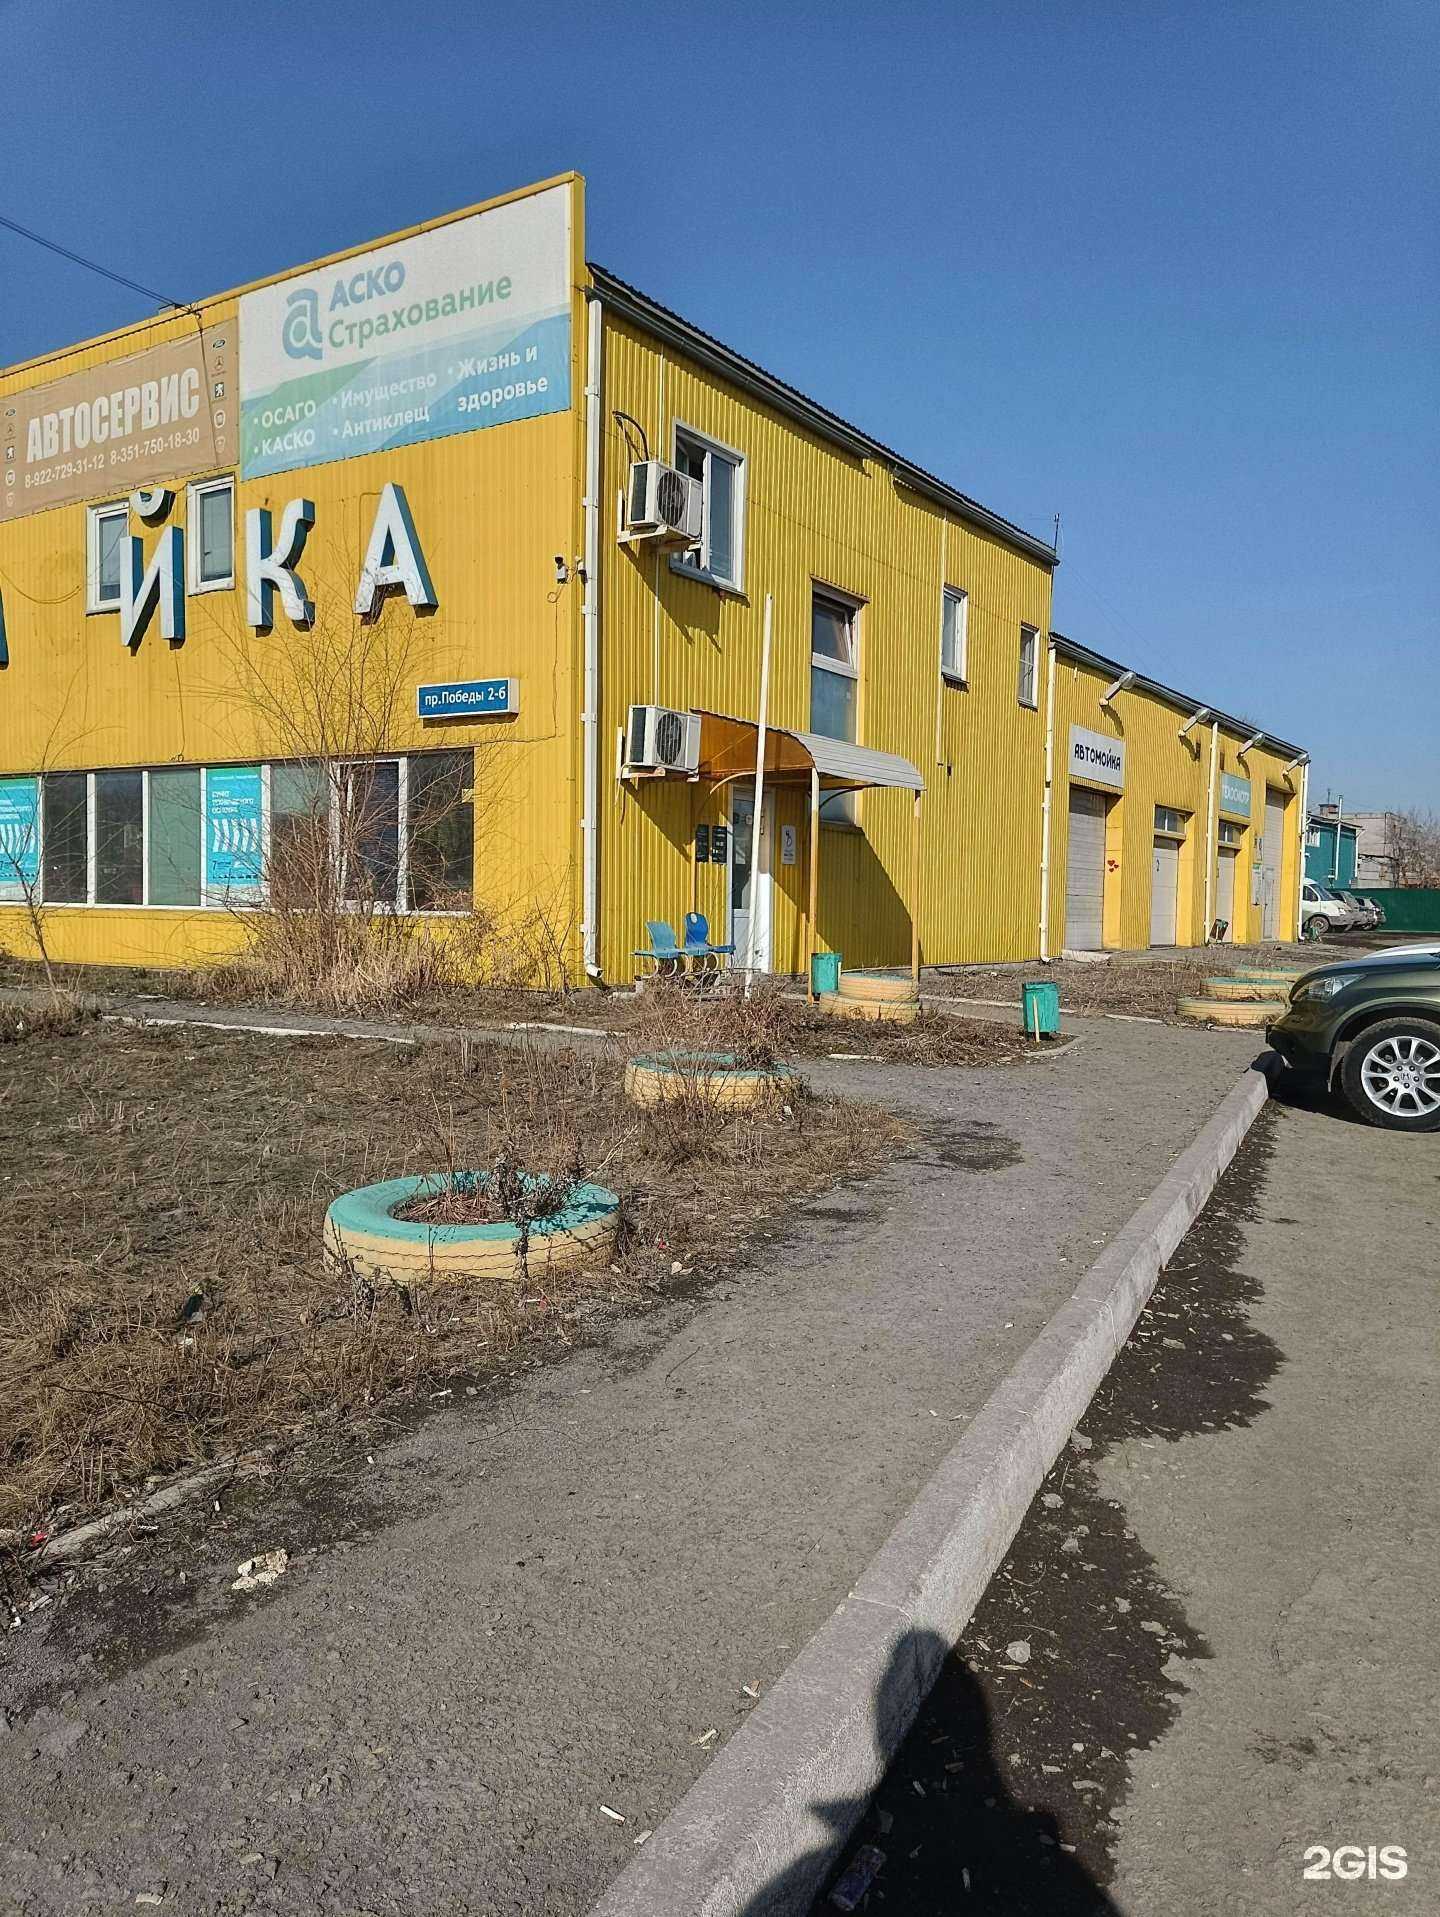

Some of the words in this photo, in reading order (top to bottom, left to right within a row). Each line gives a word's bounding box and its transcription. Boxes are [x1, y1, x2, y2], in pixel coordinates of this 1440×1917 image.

[328, 261, 407, 312] АСКО
[327, 275, 513, 350] Страхование
[458, 352, 521, 380] Жизнь
[341, 374, 438, 409] Имущество
[457, 376, 549, 413] здоровье
[26, 367, 200, 463] АВТОСЕРВИС
[261, 400, 317, 430] ОСАГО
[342, 405, 431, 439] Антиклещ
[261, 429, 317, 457] КАСКО
[24, 453, 105, 488] 8-922-729-31-12
[425, 690, 484, 708] пр.Победы
[1074, 743, 1121, 771] АВТОМОЙКА
